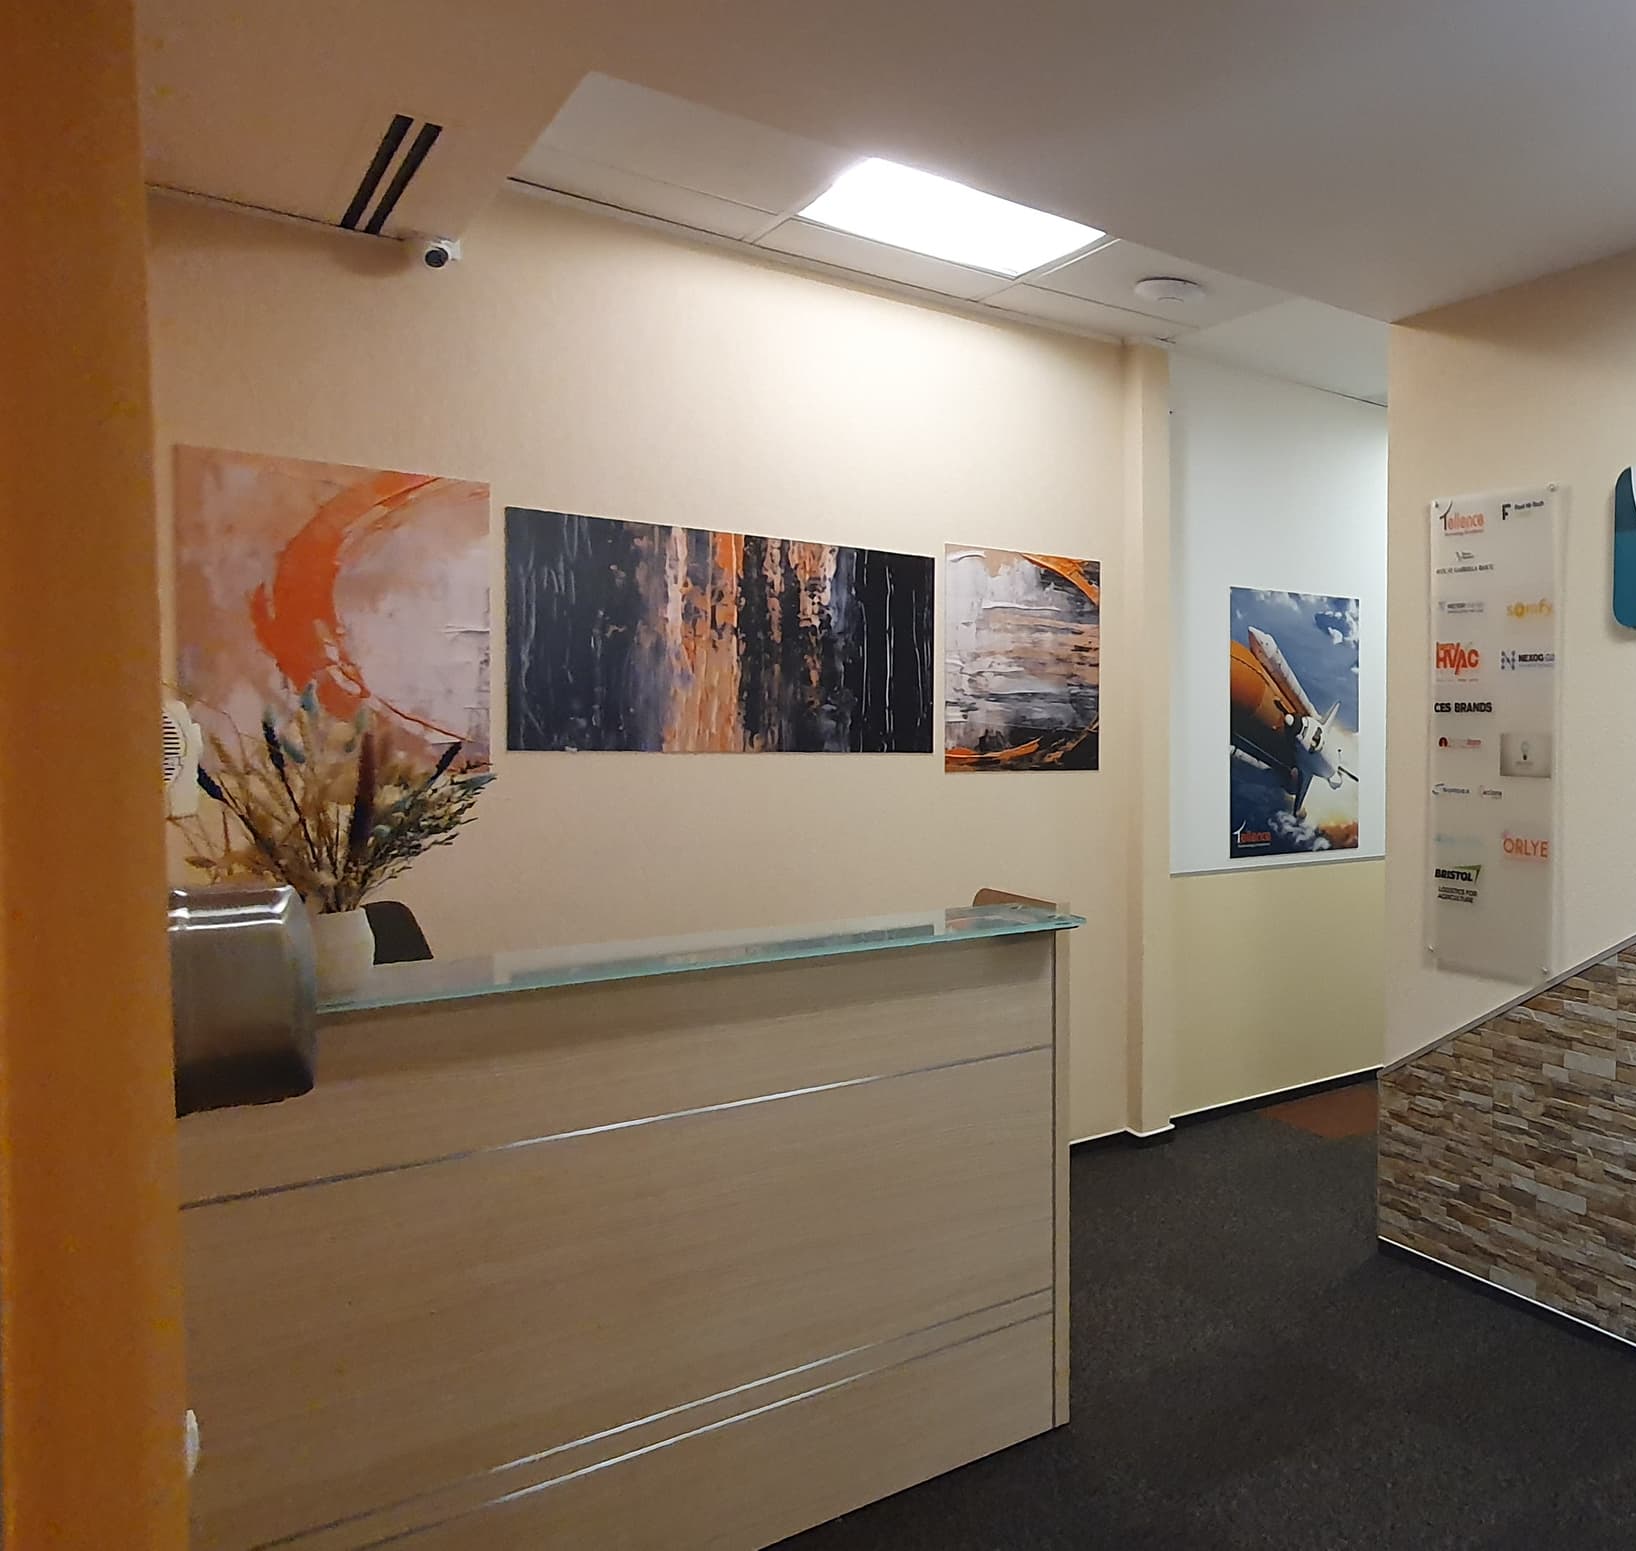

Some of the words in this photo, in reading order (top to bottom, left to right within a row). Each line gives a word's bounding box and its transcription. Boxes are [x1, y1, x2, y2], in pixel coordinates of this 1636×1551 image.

[1454, 702, 1492, 713] BRANDS
[1503, 837, 1548, 859] ORLYE
[1434, 868, 1473, 882] BRISTOL
